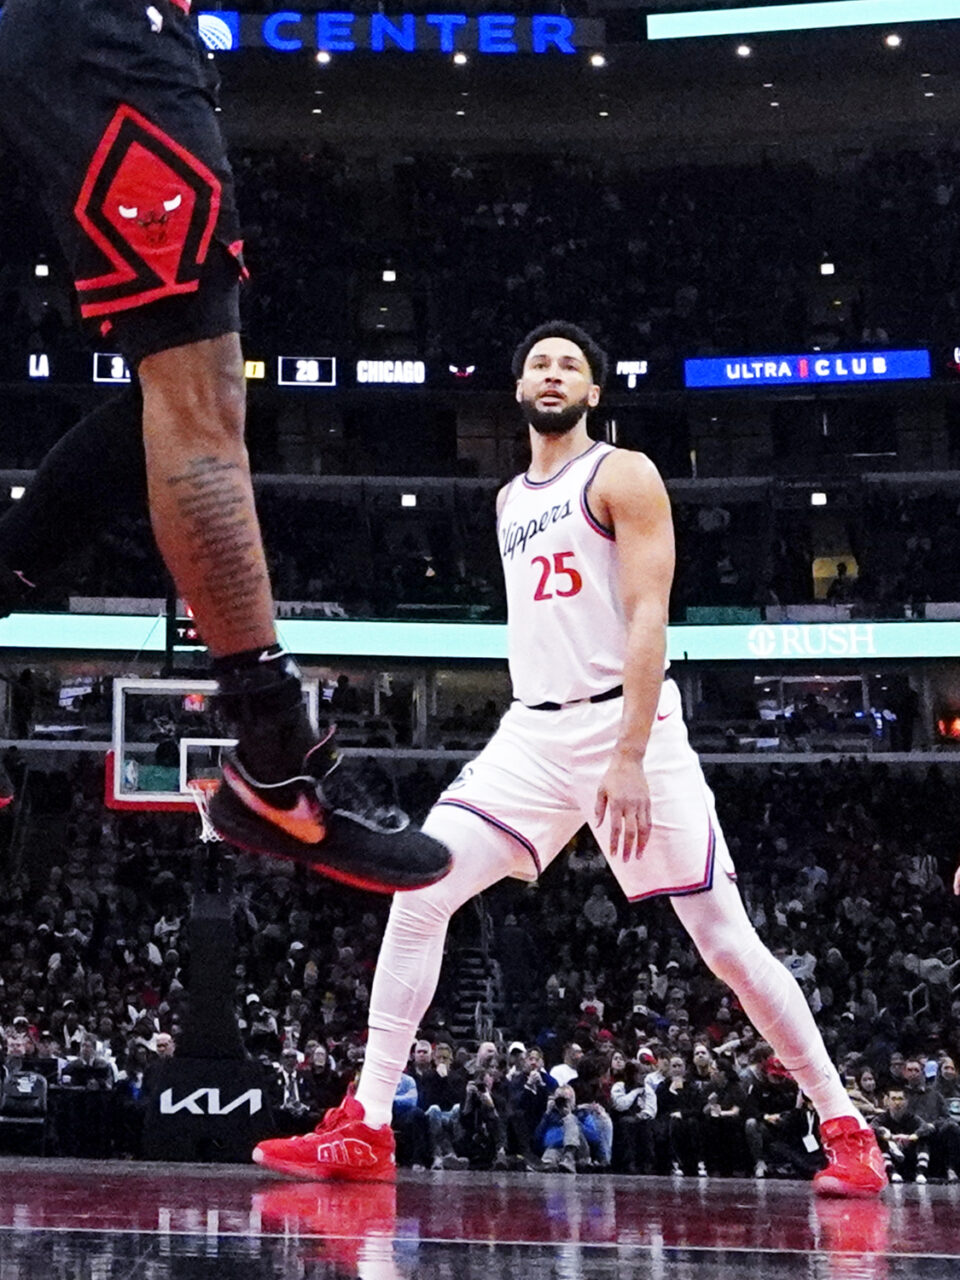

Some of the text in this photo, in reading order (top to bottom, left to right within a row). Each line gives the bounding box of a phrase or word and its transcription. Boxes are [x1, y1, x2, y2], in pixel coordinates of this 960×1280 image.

[262, 11, 577, 54] CENTER
[29, 354, 50, 377] LA
[356, 360, 425, 383] CHICAGO
[726, 357, 887, 379] ULTRA CLUB
[502, 499, 573, 561] lippers
[530, 551, 583, 601] 25
[782, 625, 876, 655] RUSH
[160, 1087, 263, 1115] KIA
